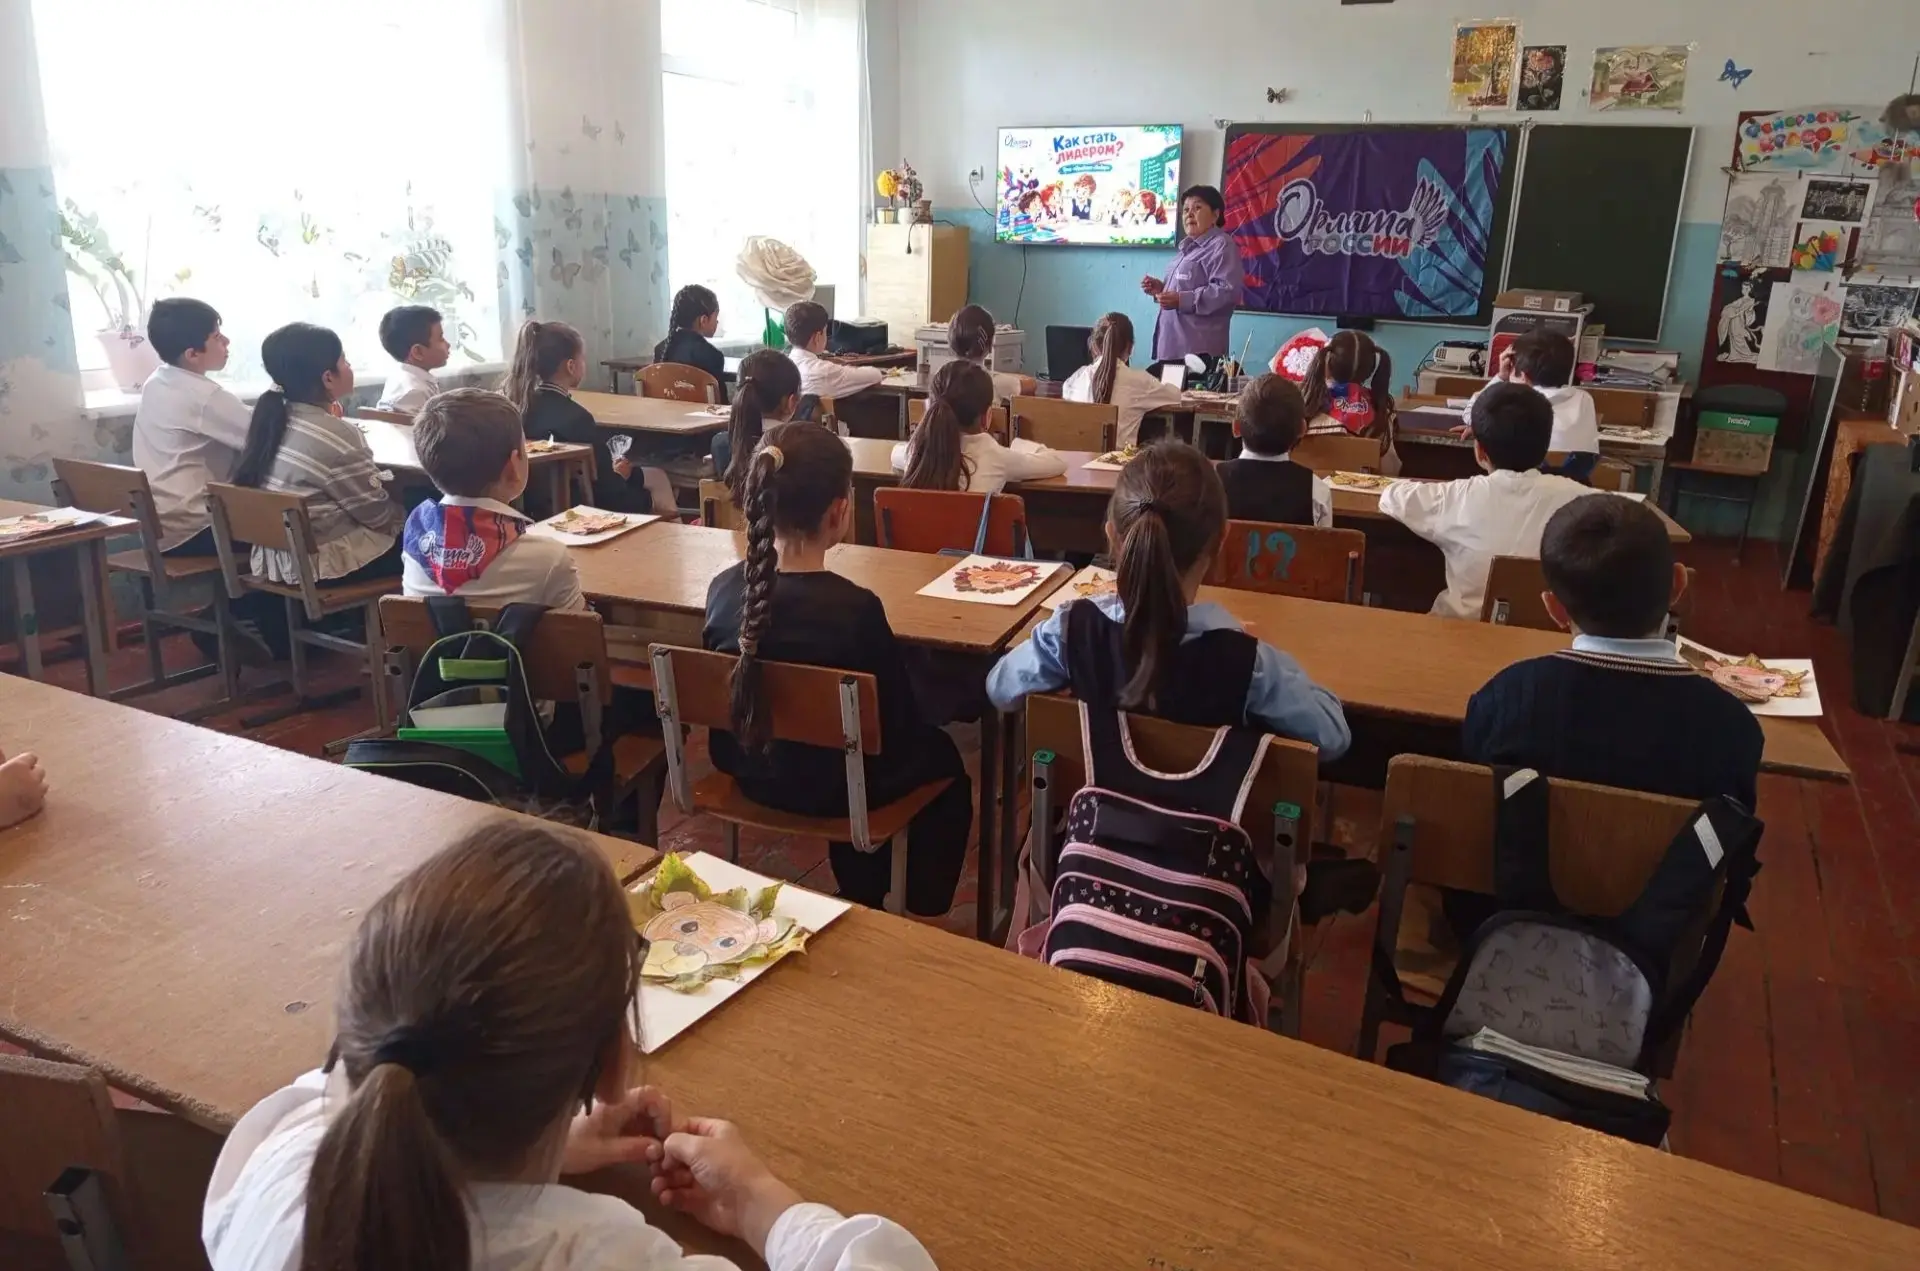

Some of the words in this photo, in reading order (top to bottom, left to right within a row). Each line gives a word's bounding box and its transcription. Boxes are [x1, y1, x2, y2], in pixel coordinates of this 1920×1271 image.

[1053, 135, 1080, 152] Как
[1083, 132, 1117, 144] стать
[1056, 141, 1124, 165] лидером?
[1275, 178, 1417, 246] Орлята
[1308, 233, 1412, 256] РОССИИ
